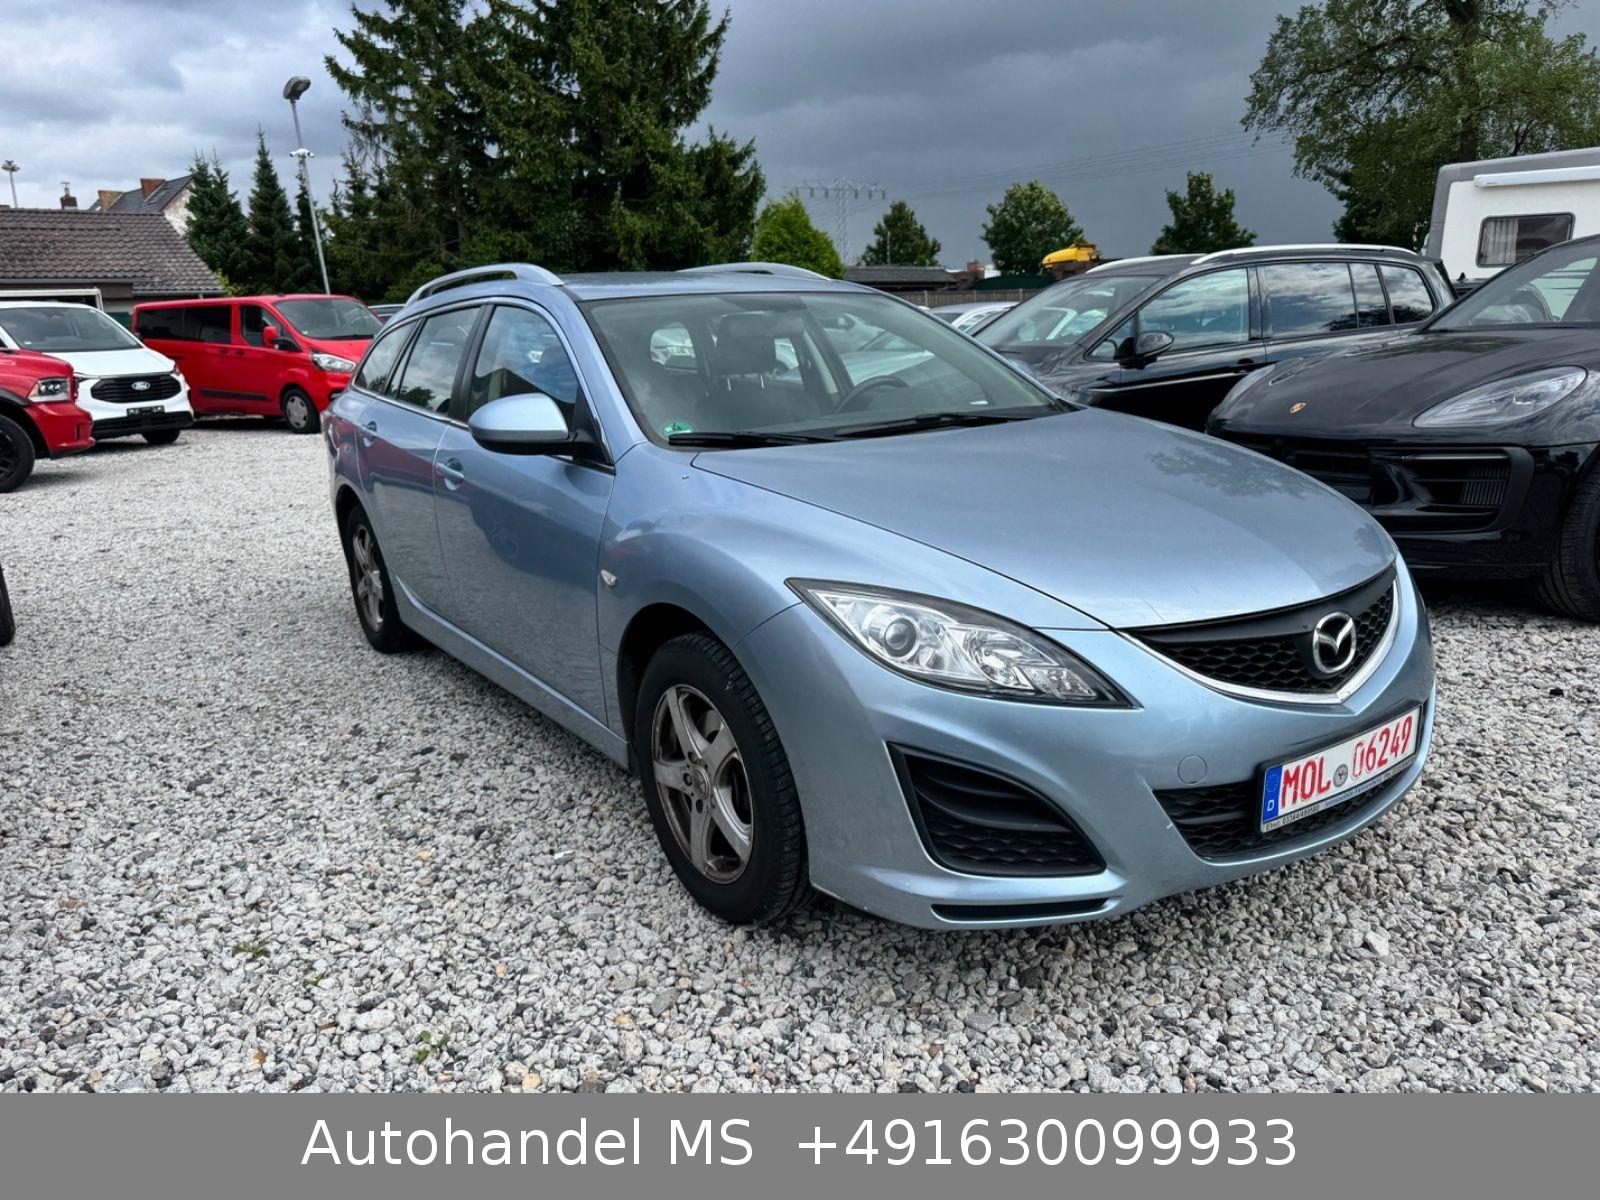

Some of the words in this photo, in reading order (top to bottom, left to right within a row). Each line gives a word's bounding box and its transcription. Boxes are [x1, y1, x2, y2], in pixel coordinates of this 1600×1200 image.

[1267, 799, 1275, 811] D
[1281, 757, 1331, 808] MOL
[1352, 716, 1412, 777] 06249
